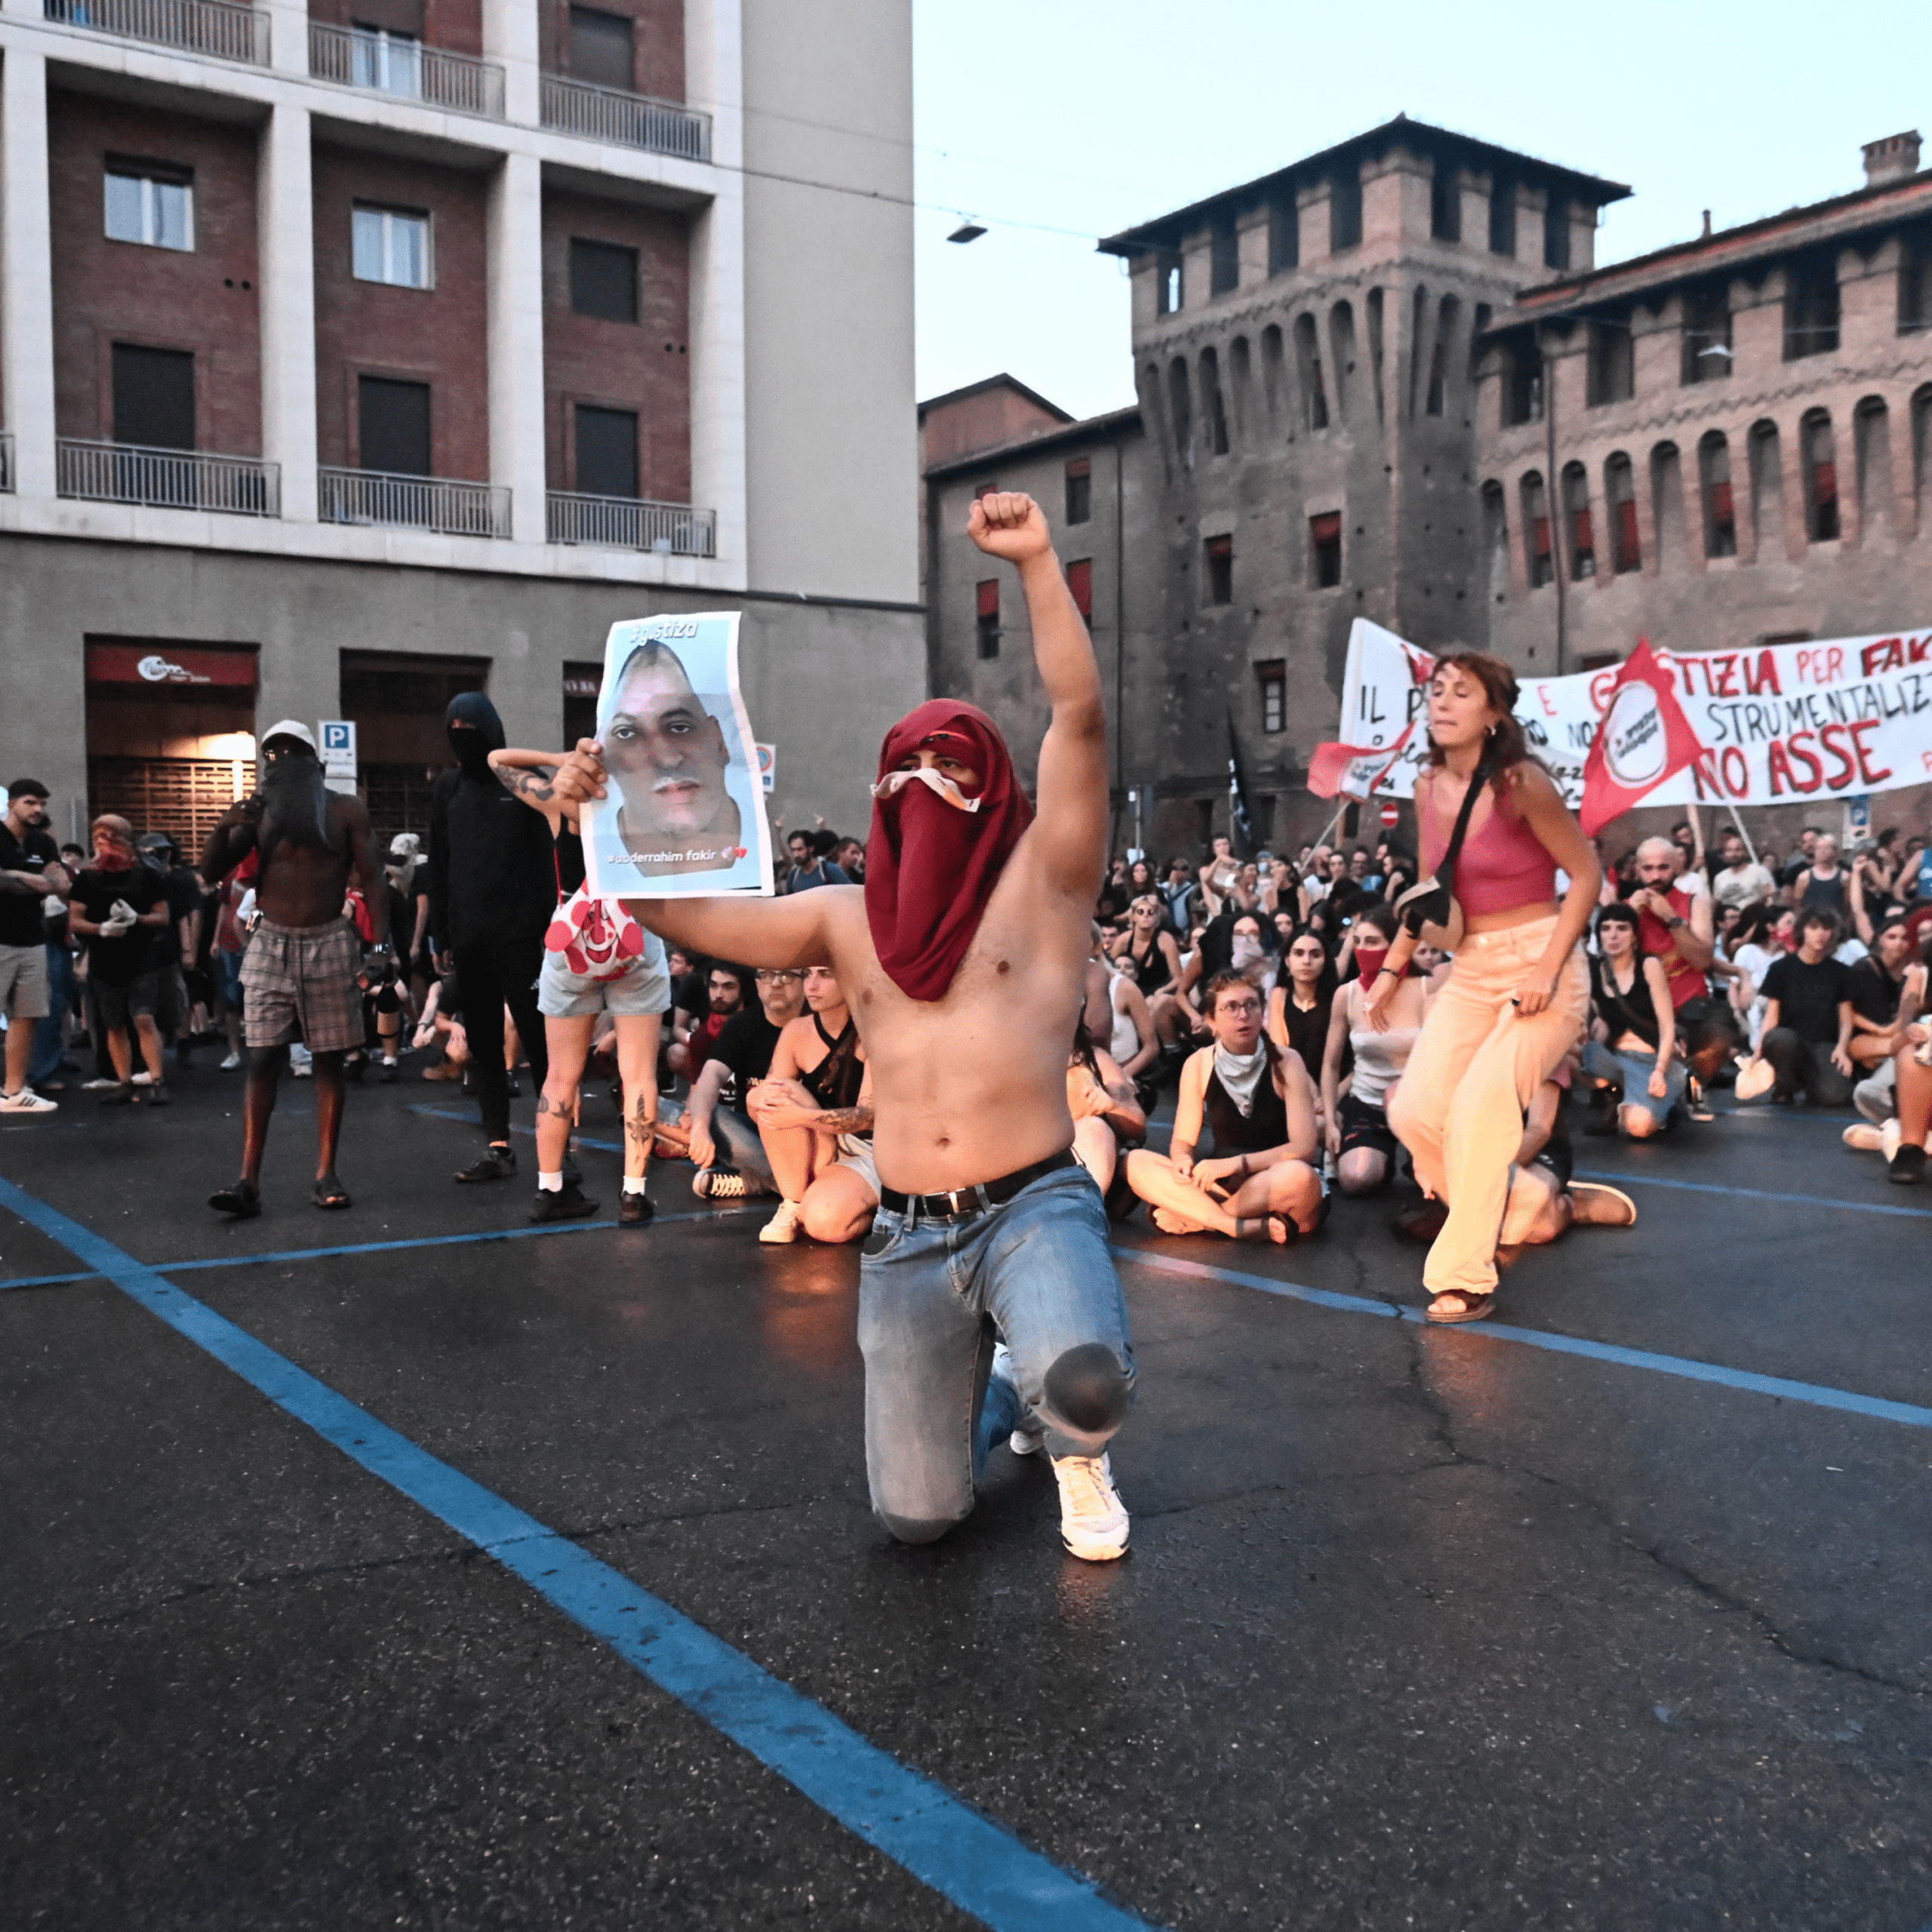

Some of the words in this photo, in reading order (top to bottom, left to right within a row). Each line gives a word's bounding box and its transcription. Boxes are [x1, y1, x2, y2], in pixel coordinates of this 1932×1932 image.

[1796, 647, 1844, 685] PER
[1360, 685, 1386, 724] IL
[1706, 670, 1932, 744] STRUMENTALIZ
[330, 728, 345, 746] P
[1691, 746, 1749, 800] NO
[1768, 719, 1893, 797] ASSE
[686, 850, 717, 861] fakir
